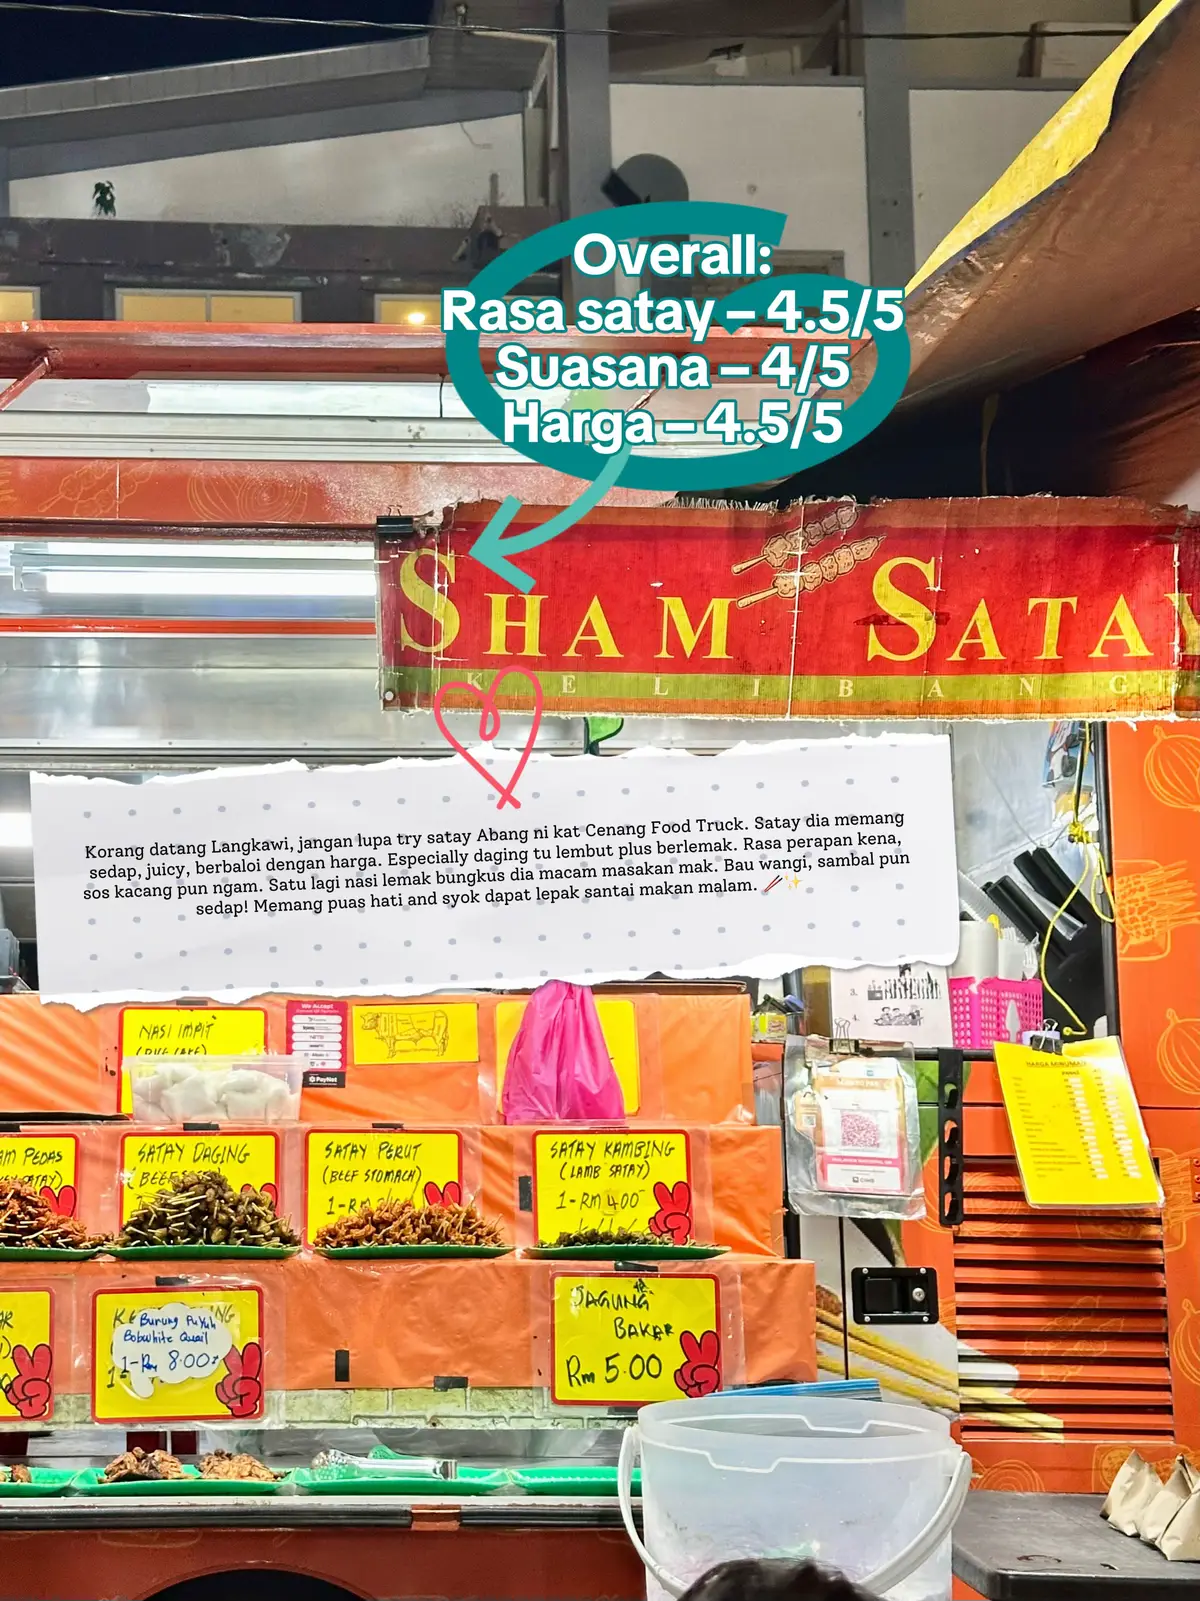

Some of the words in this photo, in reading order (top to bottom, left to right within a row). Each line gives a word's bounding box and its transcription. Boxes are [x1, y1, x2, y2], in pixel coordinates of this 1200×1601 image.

[399, 547, 736, 660] SHAM
[139, 1023, 172, 1041] NASI
[178, 1022, 214, 1041] IMPIT
[316, 1076, 338, 1084] PayNet
[23, 1147, 63, 1166] PEDAS
[138, 1142, 185, 1164] SATAY
[193, 1142, 251, 1164] DAGING
[325, 1141, 367, 1161] SATAY
[378, 1141, 422, 1161] PERUT
[550, 1138, 596, 1160] SATAY
[604, 1139, 675, 1159] KAMBING
[323, 1165, 359, 1184] (BEEF
[364, 1165, 422, 1184] STOMACH)
[609, 1160, 650, 1181] SATAY)
[571, 1285, 650, 1311] JAGUNG
[140, 1311, 179, 1330] Burung
[614, 1316, 675, 1341] BAKAR
[122, 1330, 173, 1344] Bobwhite
[180, 1331, 208, 1345] Quail
[604, 1352, 663, 1384] 5.00
